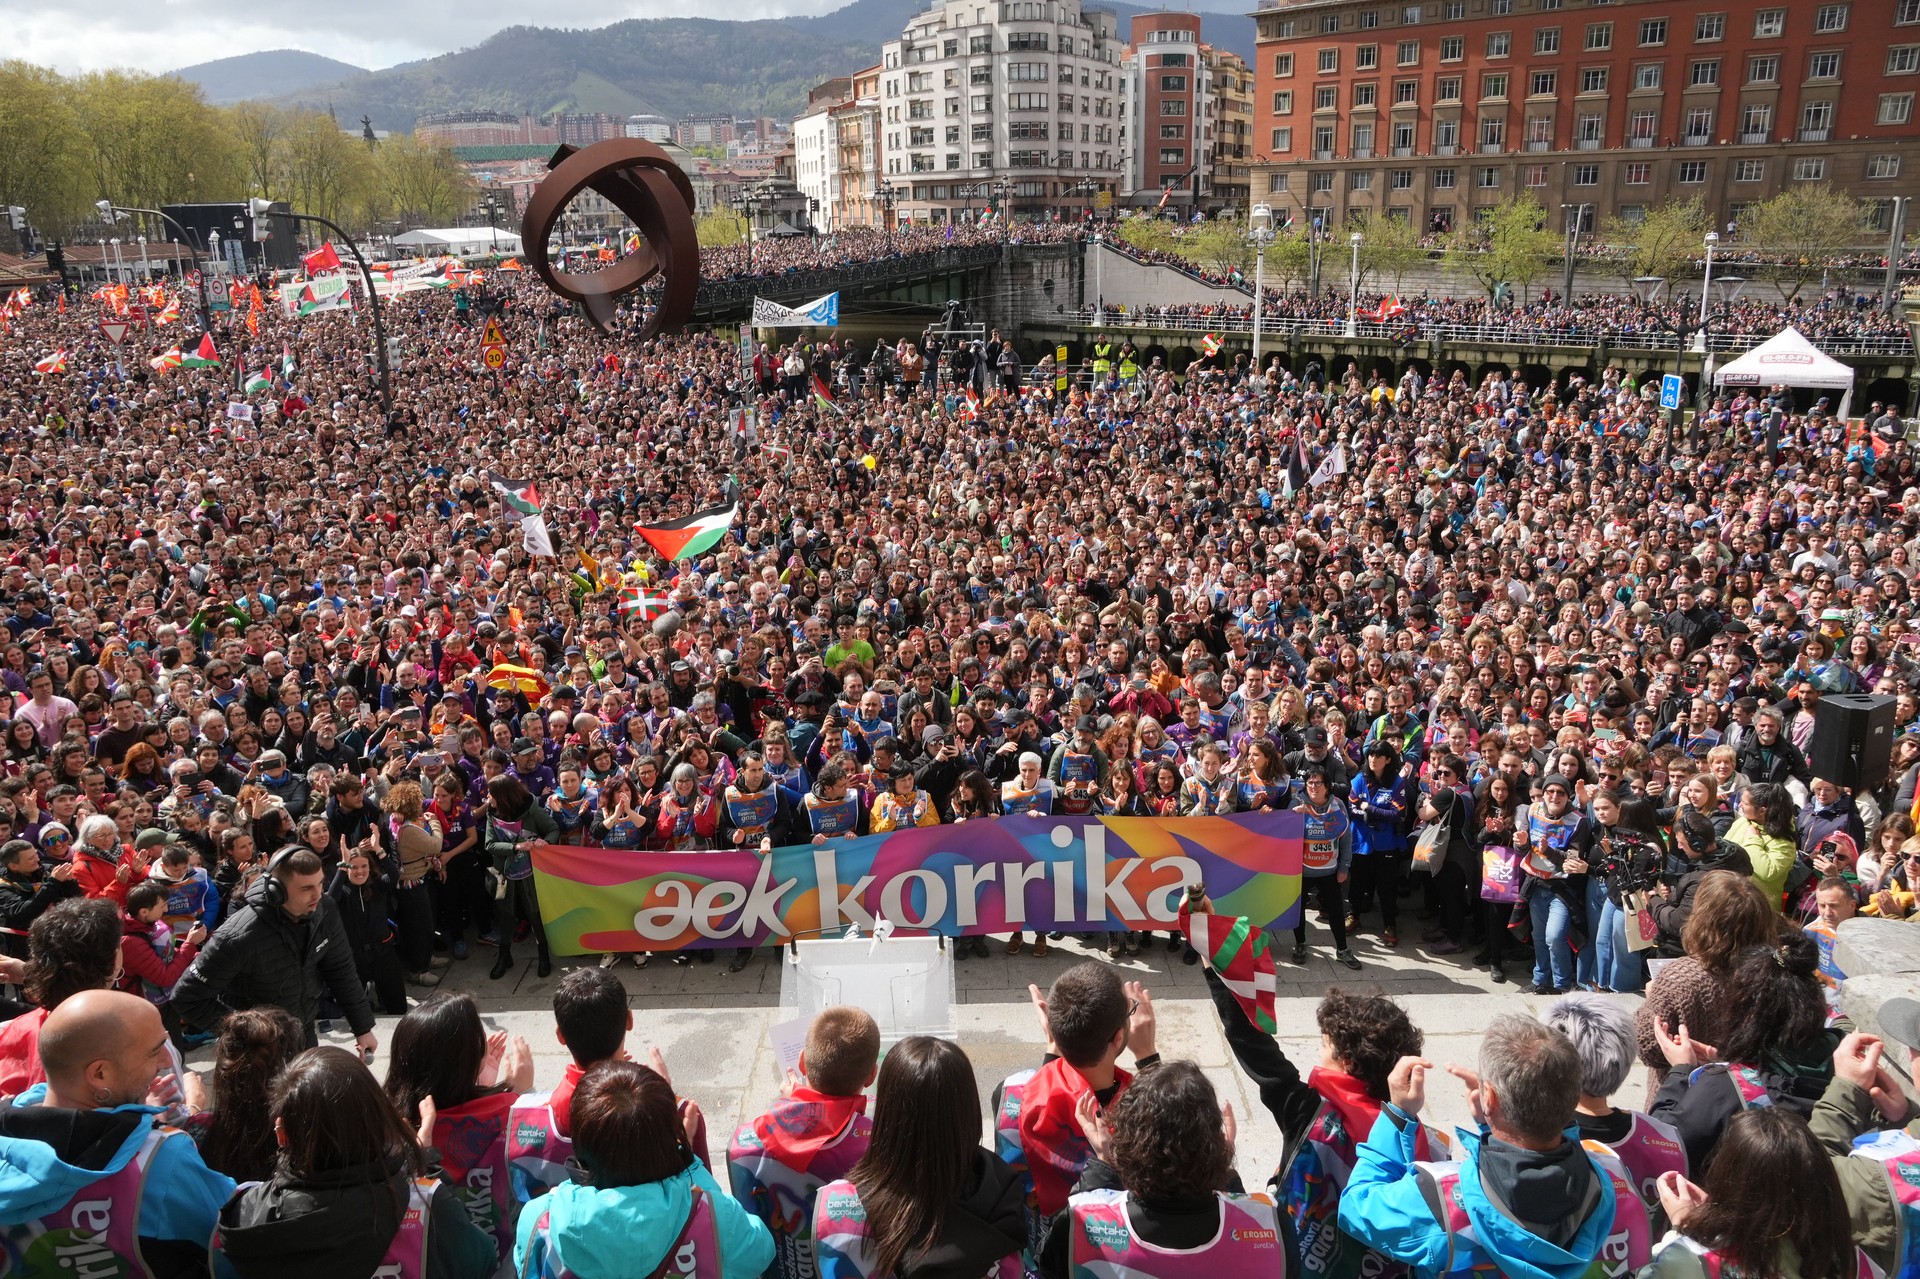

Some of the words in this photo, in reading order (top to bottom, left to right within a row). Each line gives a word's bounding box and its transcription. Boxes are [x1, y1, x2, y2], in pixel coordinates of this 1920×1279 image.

[489, 353, 501, 363] 30
[1073, 789, 1090, 799] 343
[633, 854, 798, 941] aek
[813, 823, 1203, 935] korrika
[517, 1128, 546, 1138] bertako
[1651, 1139, 1678, 1149] EROSKI
[1085, 1223, 1129, 1237] bertako
[1243, 1230, 1274, 1240] EROSKI
[1304, 1224, 1336, 1275] gara
